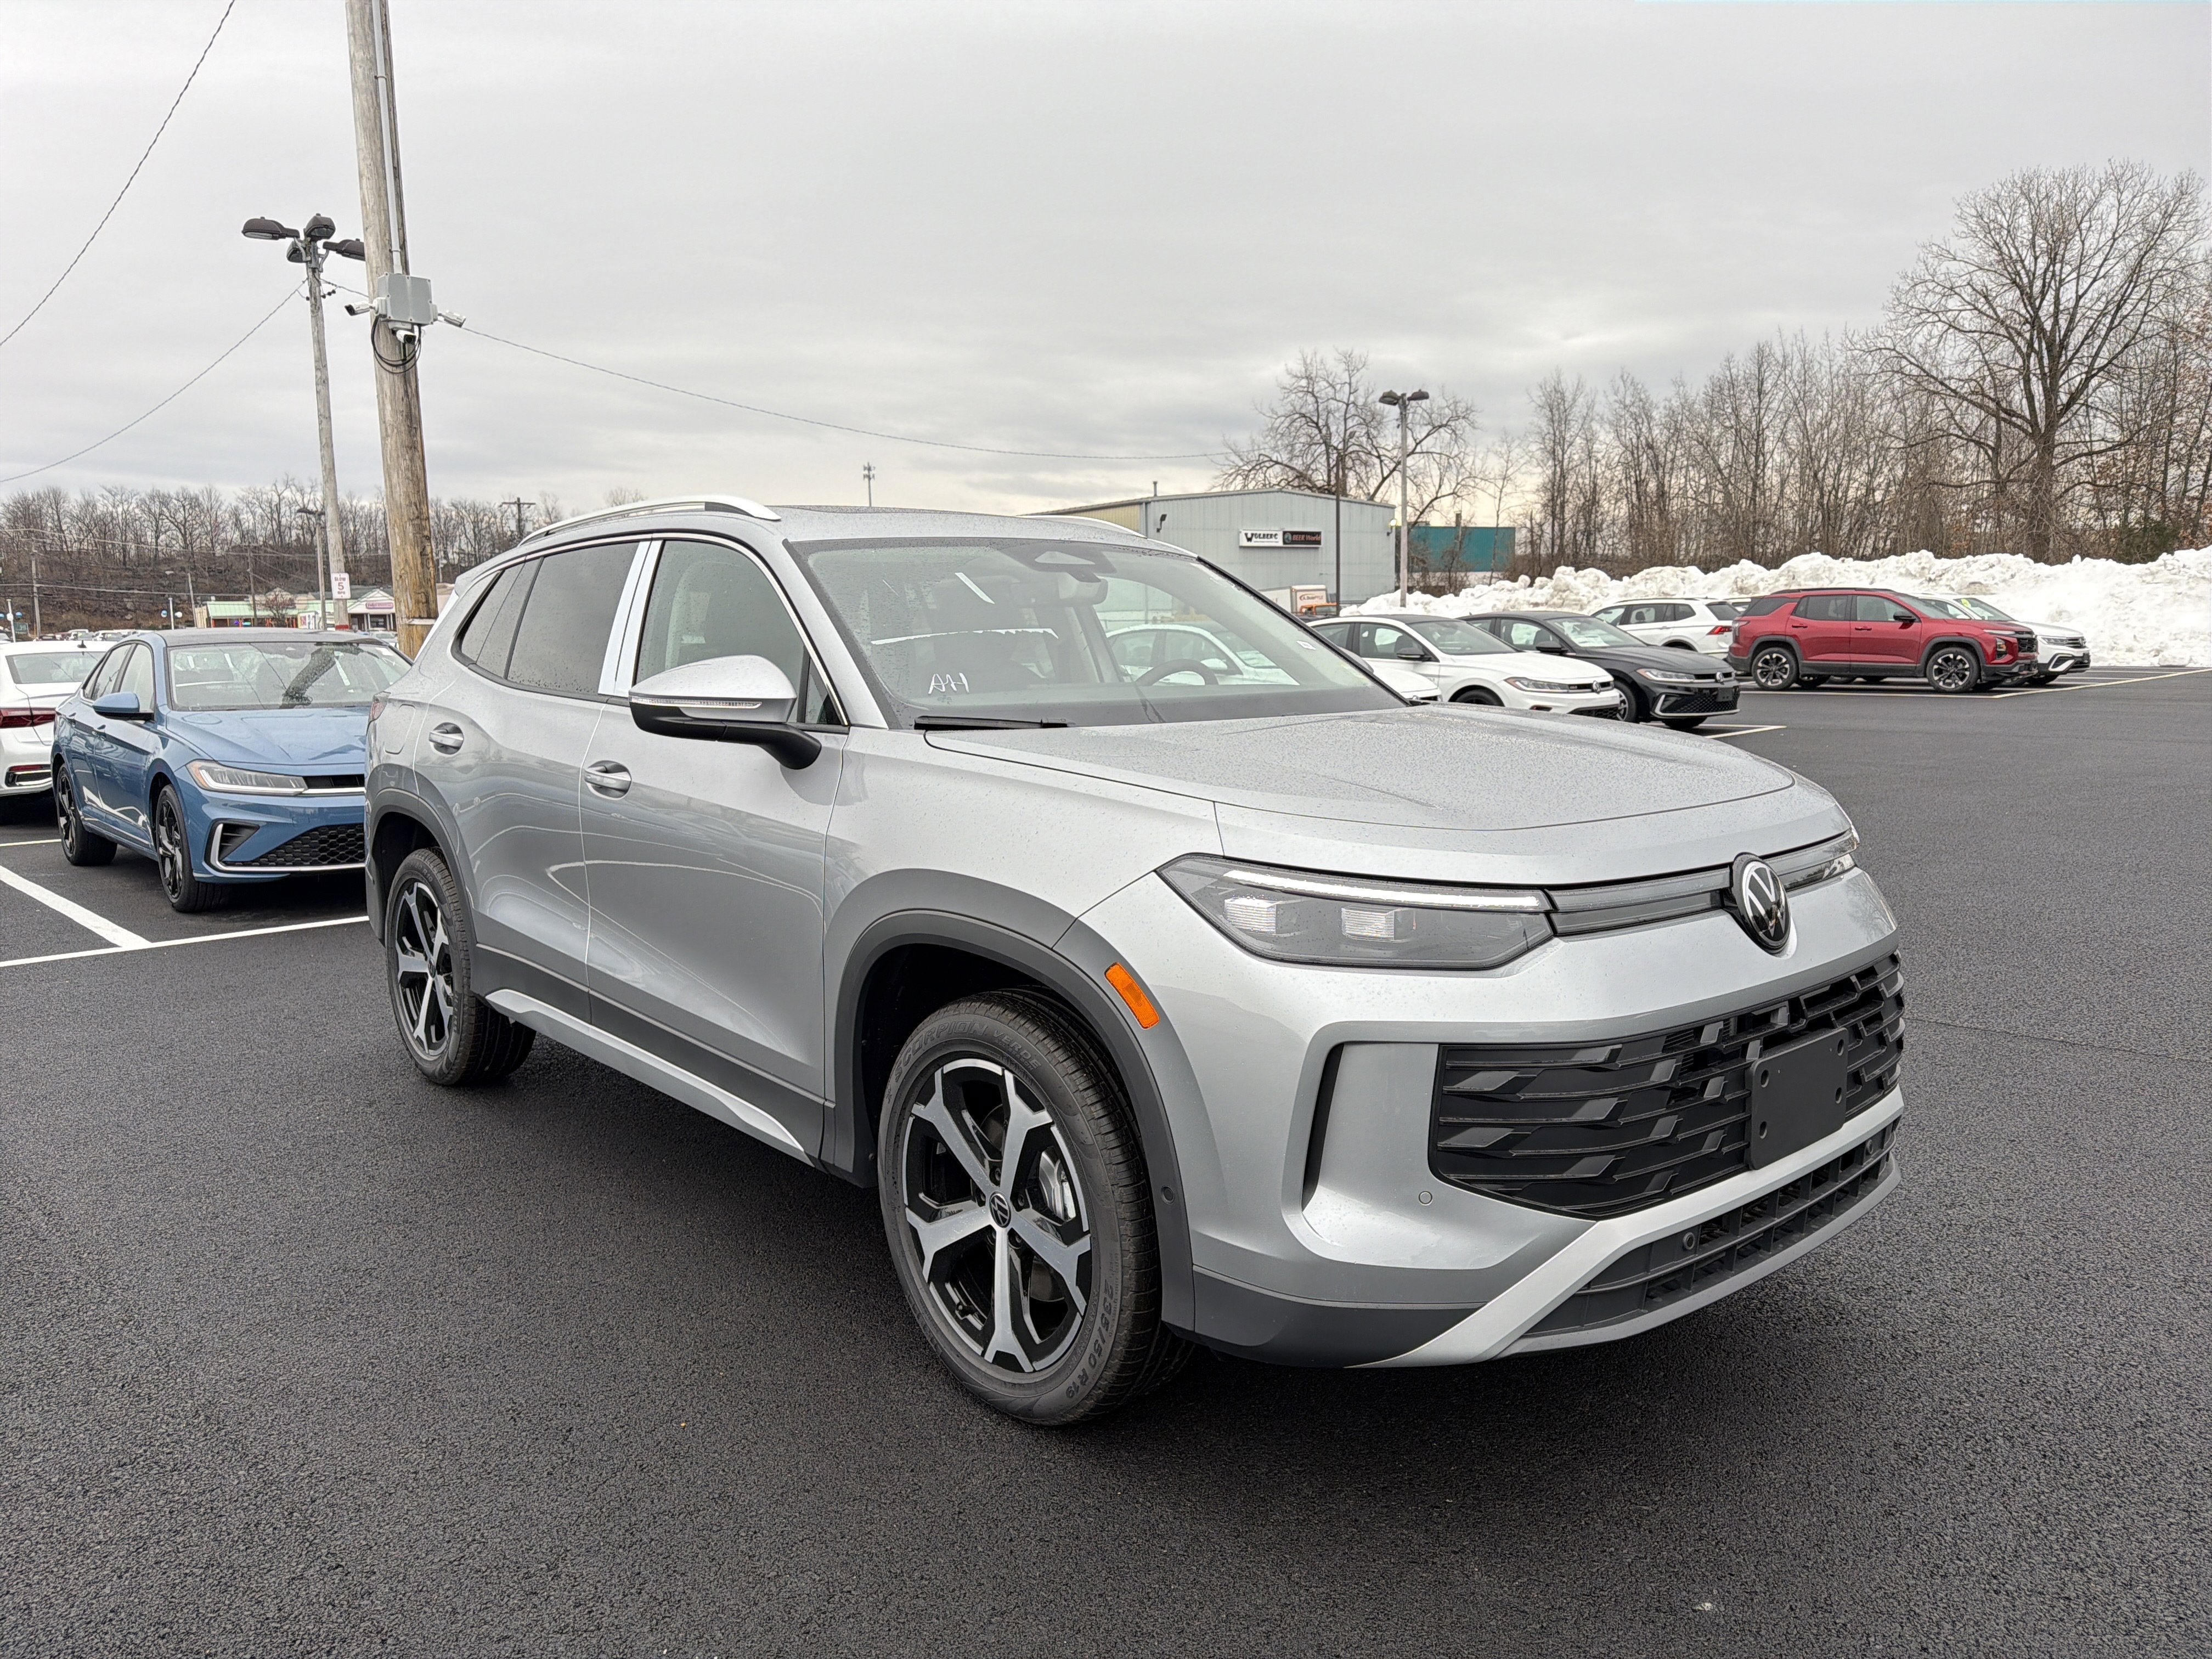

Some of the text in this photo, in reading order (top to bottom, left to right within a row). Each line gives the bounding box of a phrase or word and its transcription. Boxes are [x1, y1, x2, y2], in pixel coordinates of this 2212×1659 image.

[338, 582, 345, 590] 5
[894, 1019, 1042, 1083] SCORPION VERDE
[1088, 1278, 1114, 1370] 235/50
[1065, 1368, 1089, 1398] R19
